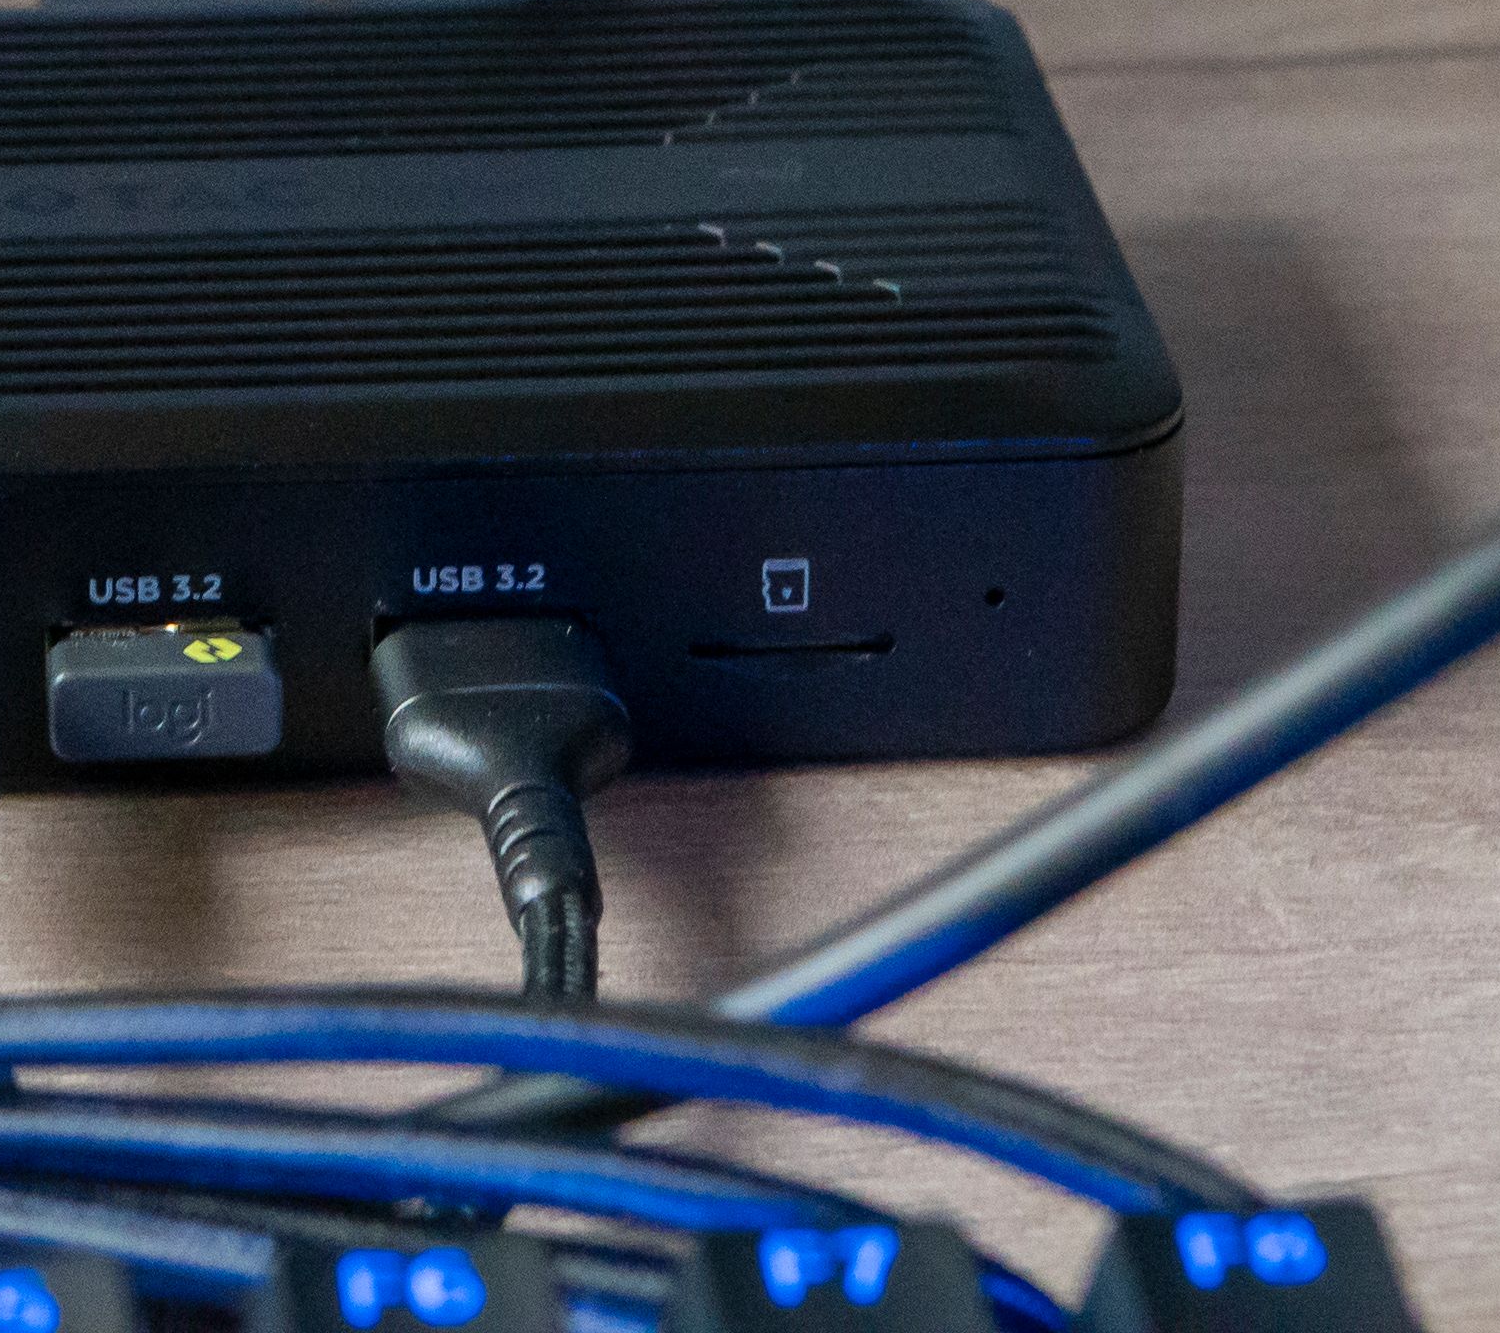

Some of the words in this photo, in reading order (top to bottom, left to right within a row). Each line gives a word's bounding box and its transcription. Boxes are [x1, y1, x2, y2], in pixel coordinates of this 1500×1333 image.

[88, 576, 161, 605] USB
[171, 573, 223, 602] 3.2
[412, 565, 485, 593] USB
[495, 562, 546, 591] 3.2
[121, 686, 215, 749] logi
